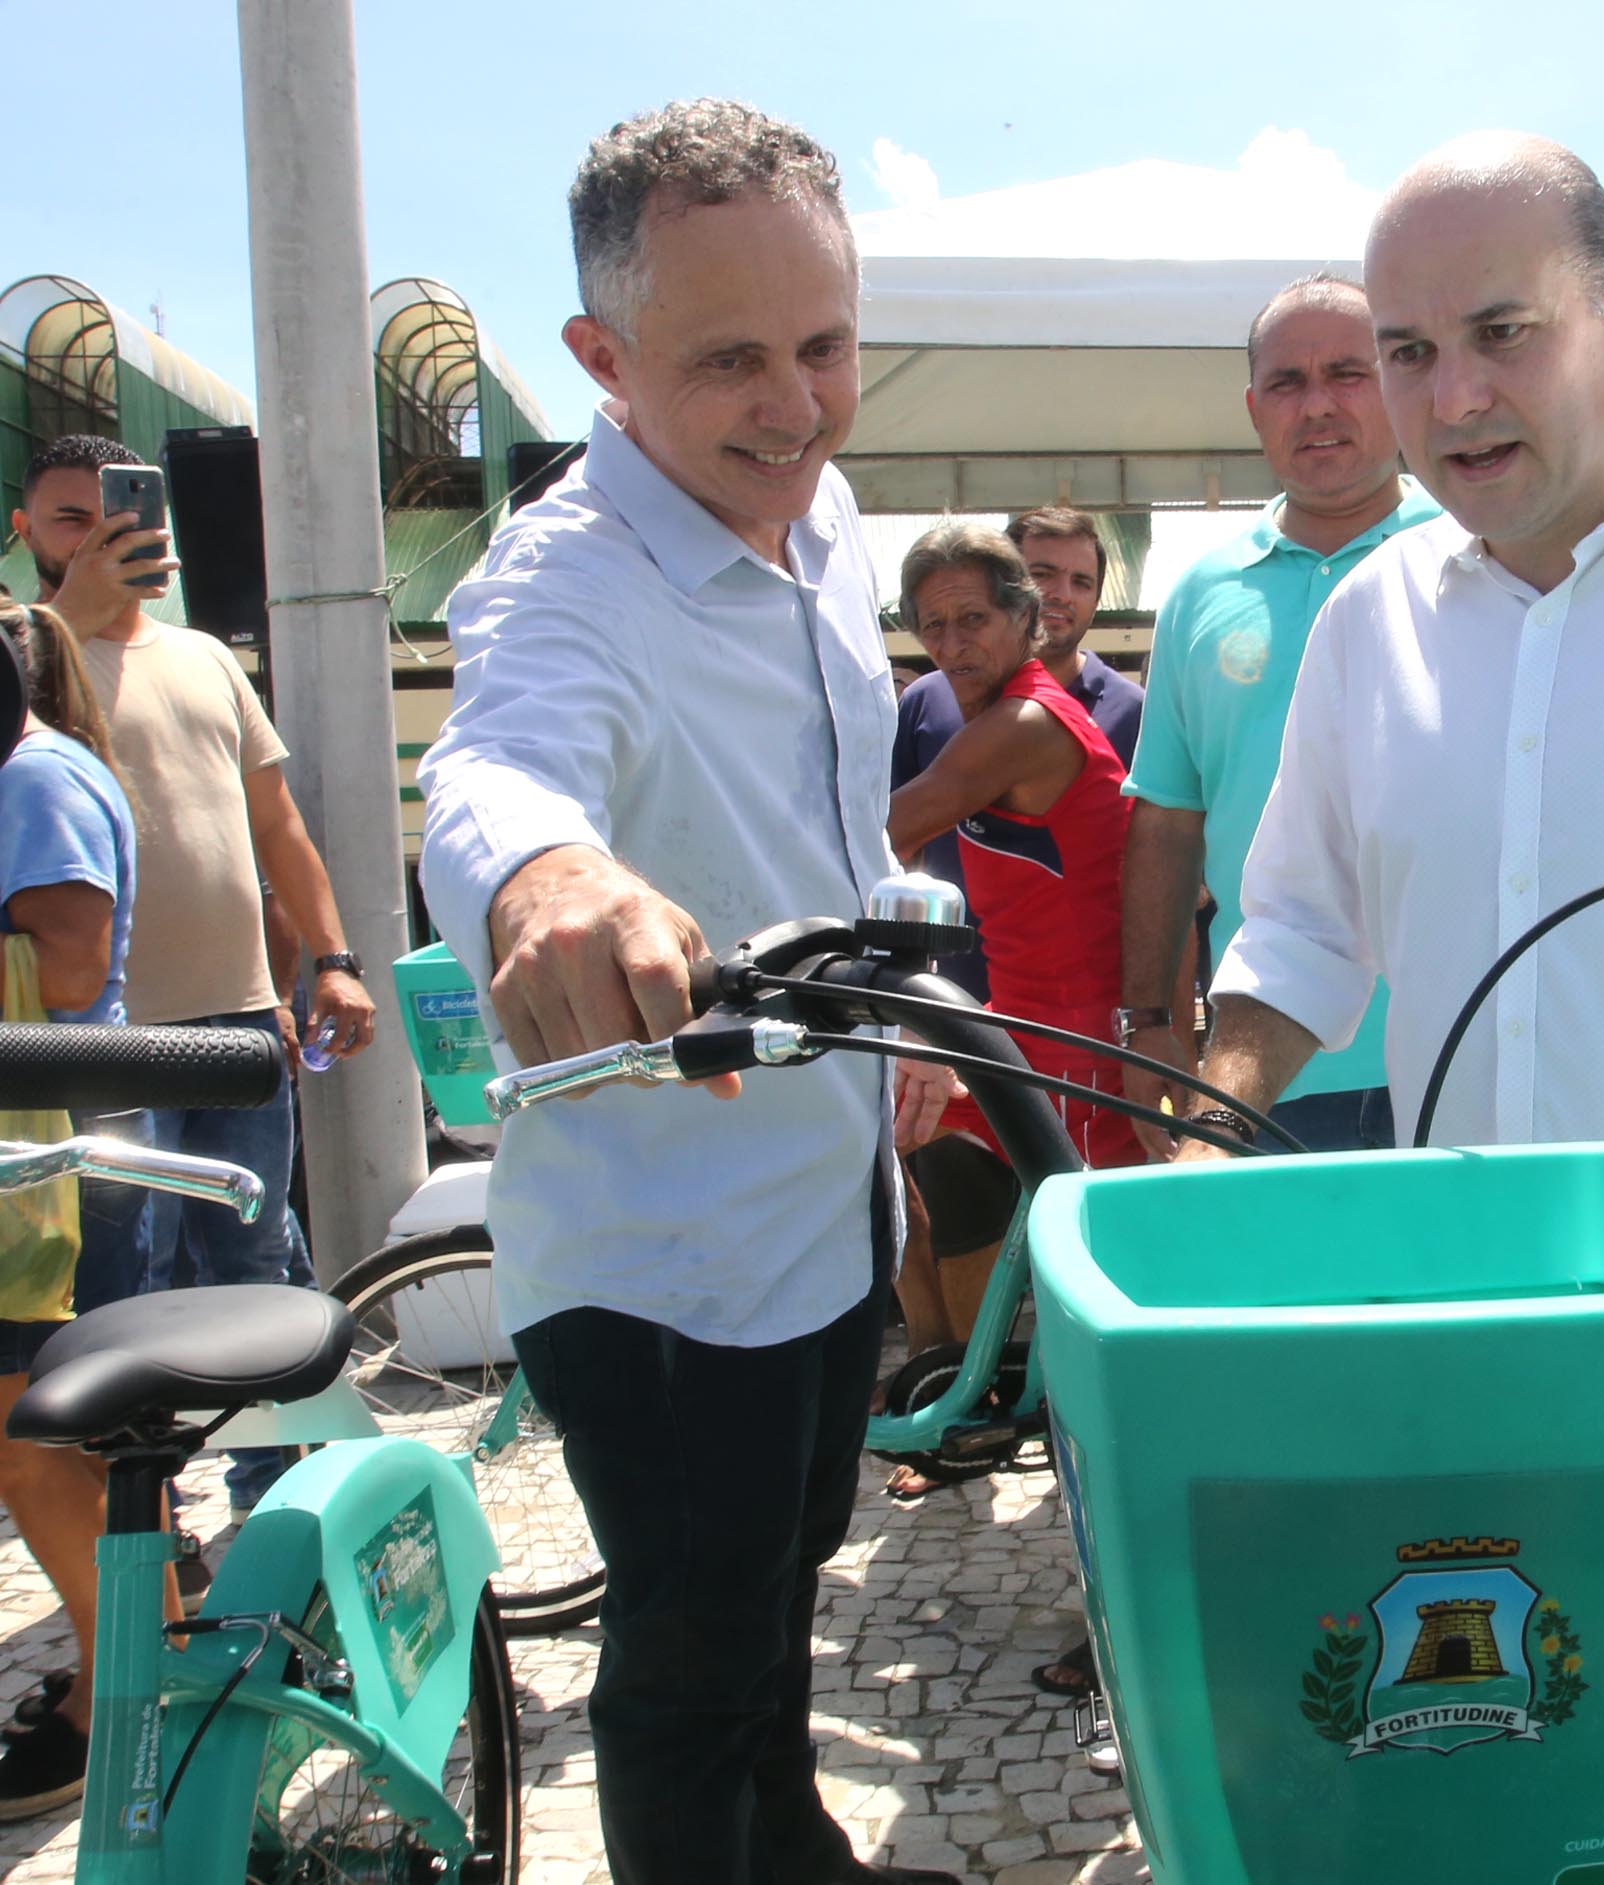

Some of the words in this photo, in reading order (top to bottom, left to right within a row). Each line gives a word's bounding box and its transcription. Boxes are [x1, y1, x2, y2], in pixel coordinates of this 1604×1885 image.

[131, 1722, 150, 1789] Prefeitura
[142, 1703, 152, 1720] de
[1374, 1707, 1518, 1738] FORTITUDINE
